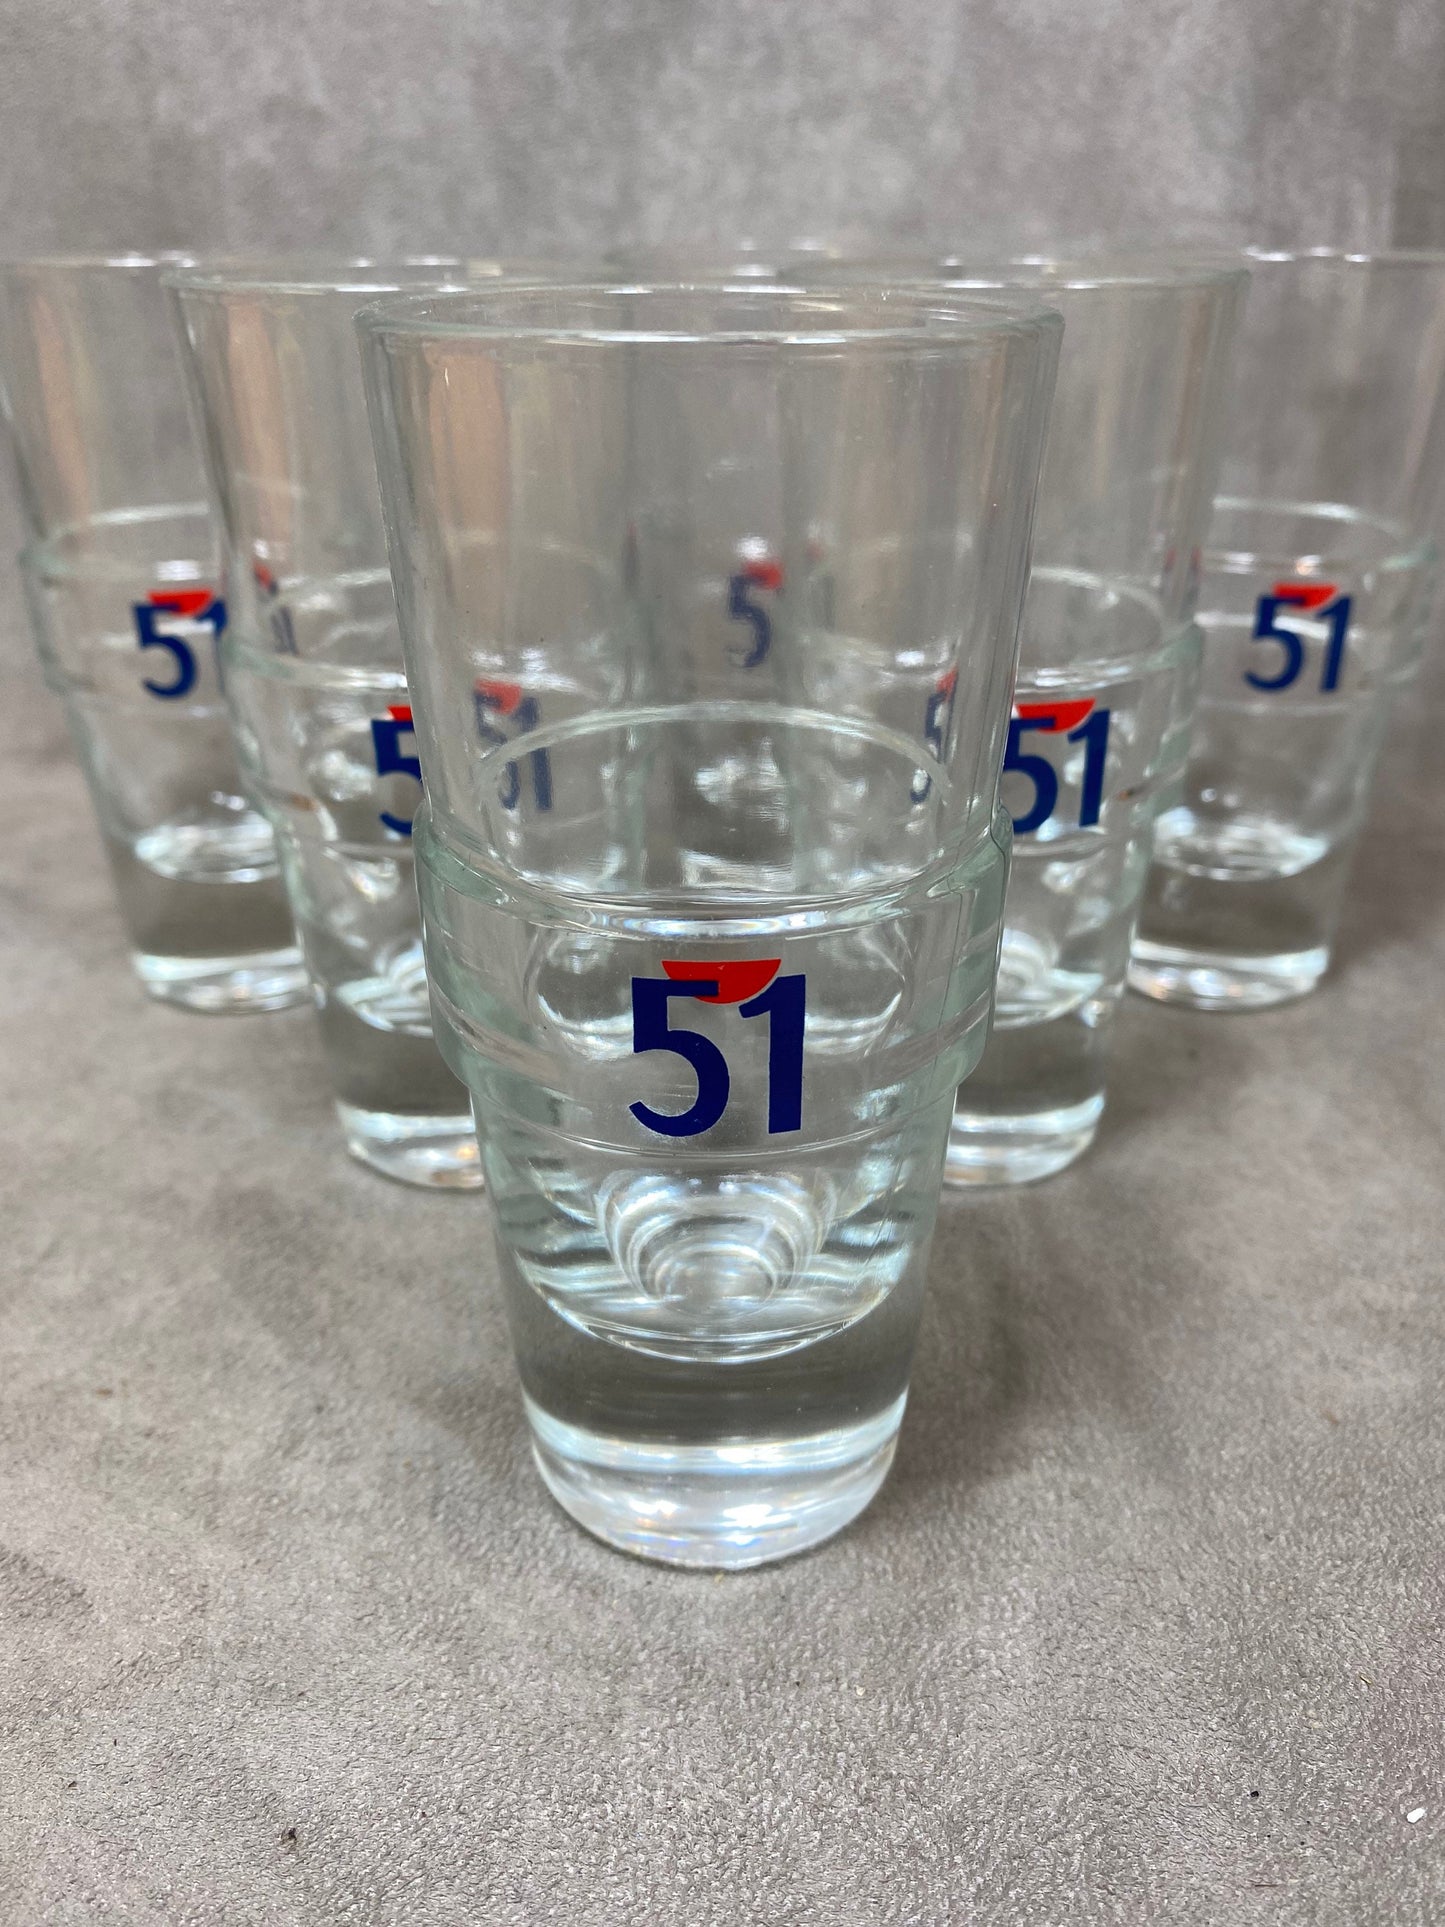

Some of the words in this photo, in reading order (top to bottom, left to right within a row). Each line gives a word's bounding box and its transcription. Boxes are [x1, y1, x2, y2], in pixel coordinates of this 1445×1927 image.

[1243, 594, 1353, 693] 51
[1001, 708, 1112, 836] 51
[628, 973, 807, 1138] 51
